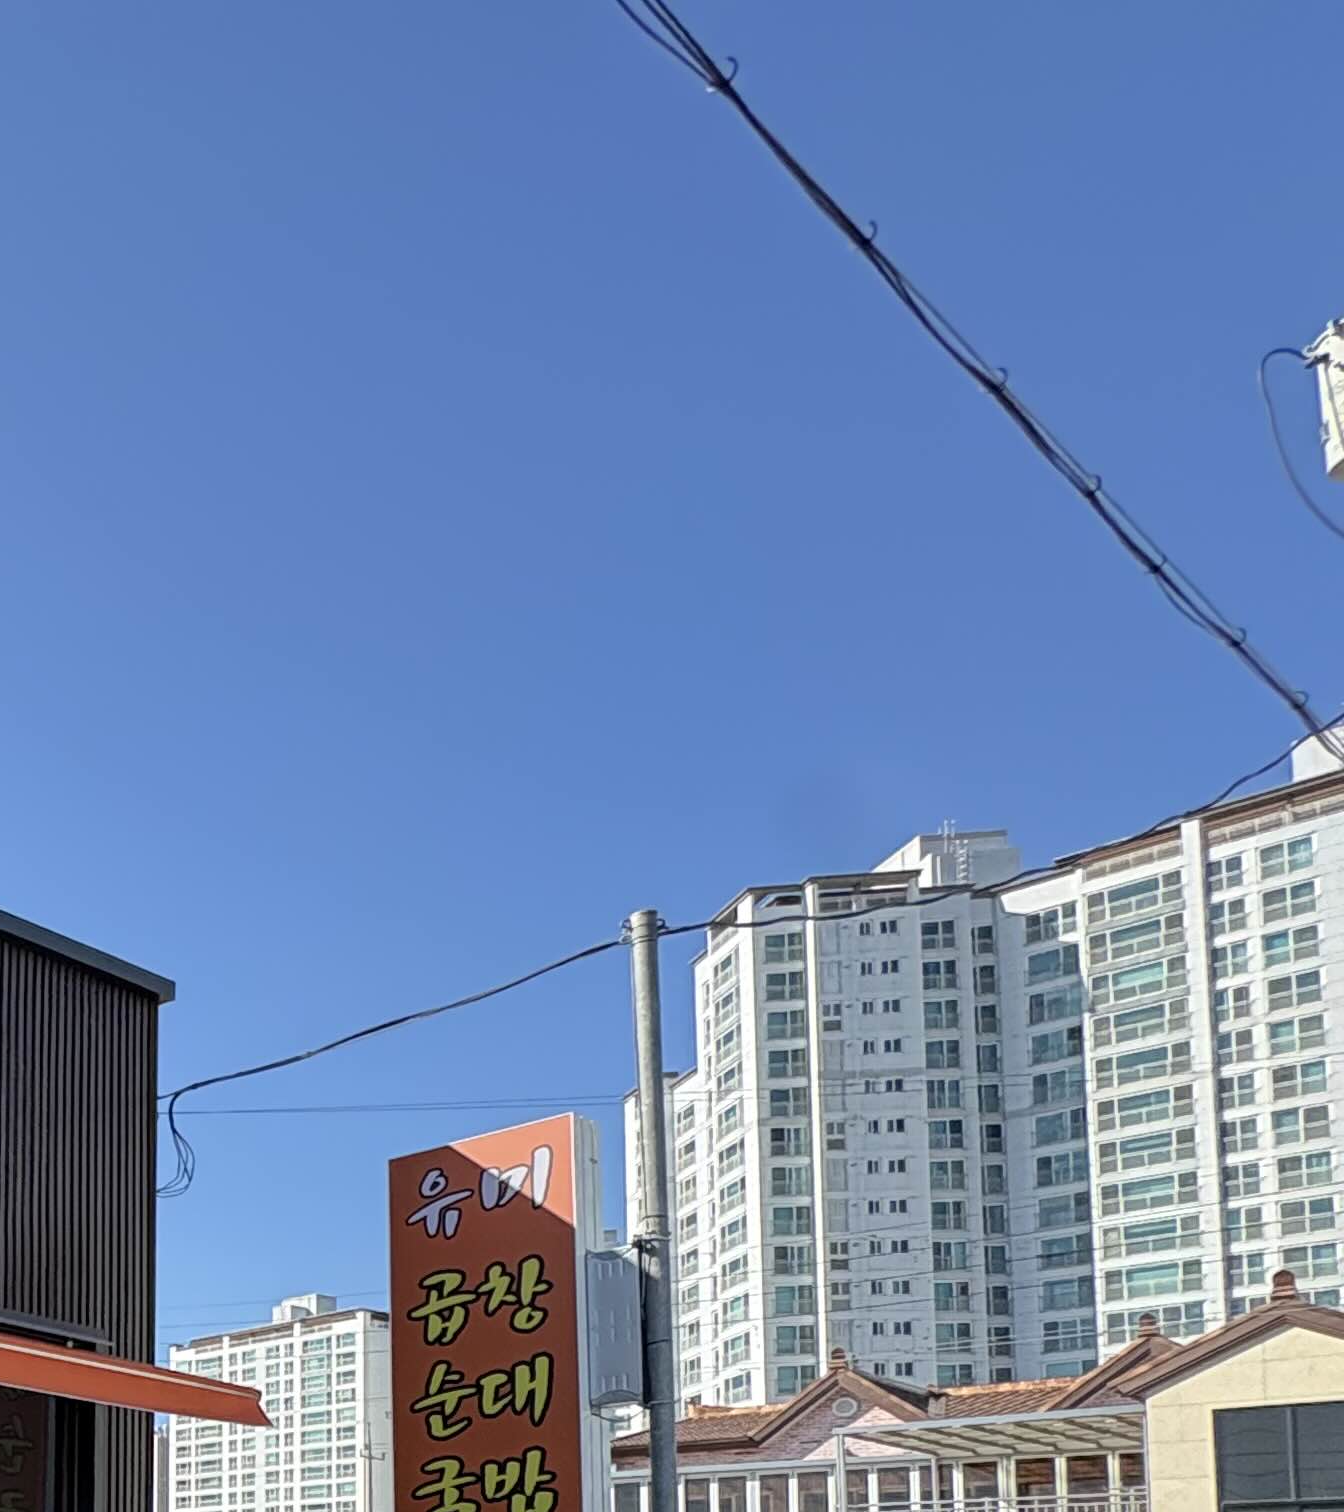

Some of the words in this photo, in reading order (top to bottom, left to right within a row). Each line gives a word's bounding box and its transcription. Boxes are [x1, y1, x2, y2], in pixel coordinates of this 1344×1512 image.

[407, 1144, 554, 1239] 유미
[408, 1254, 554, 1347] 곱창
[410, 1351, 554, 1441] 순대
